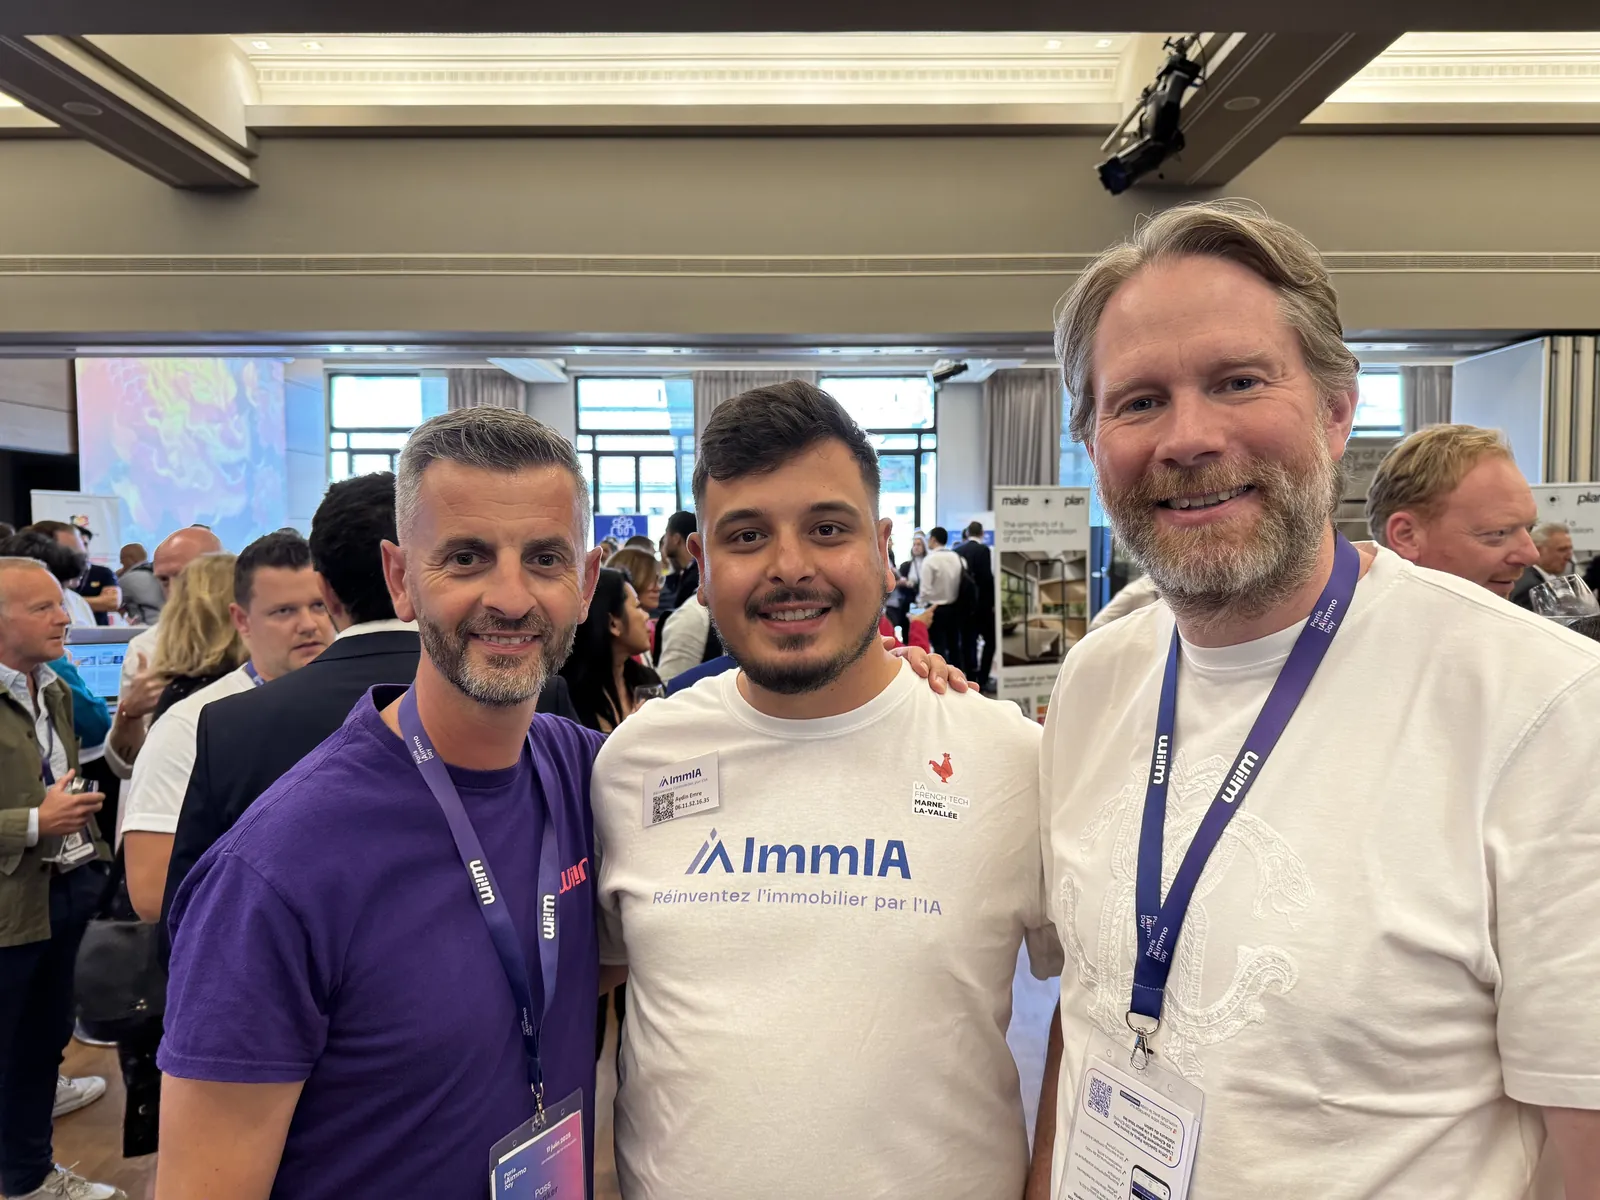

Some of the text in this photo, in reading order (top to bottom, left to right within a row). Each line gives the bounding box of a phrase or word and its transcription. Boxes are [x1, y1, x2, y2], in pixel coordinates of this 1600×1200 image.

[1002, 494, 1085, 508] make plan
[1577, 492, 1600, 506] pla
[1310, 610, 1323, 628] Paris
[1324, 620, 1336, 634] Day
[670, 768, 702, 784] ImmIA
[914, 791, 968, 805] FRENCH TECH
[914, 799, 946, 808] MARNE-
[914, 808, 958, 819] LA-VALLÉE
[742, 837, 912, 880] ImmIA
[653, 890, 750, 904] Réinventez
[874, 896, 906, 912] par
[1146, 939, 1156, 957] Paris
[1160, 950, 1168, 963] Day
[534, 1181, 551, 1199] Pass
